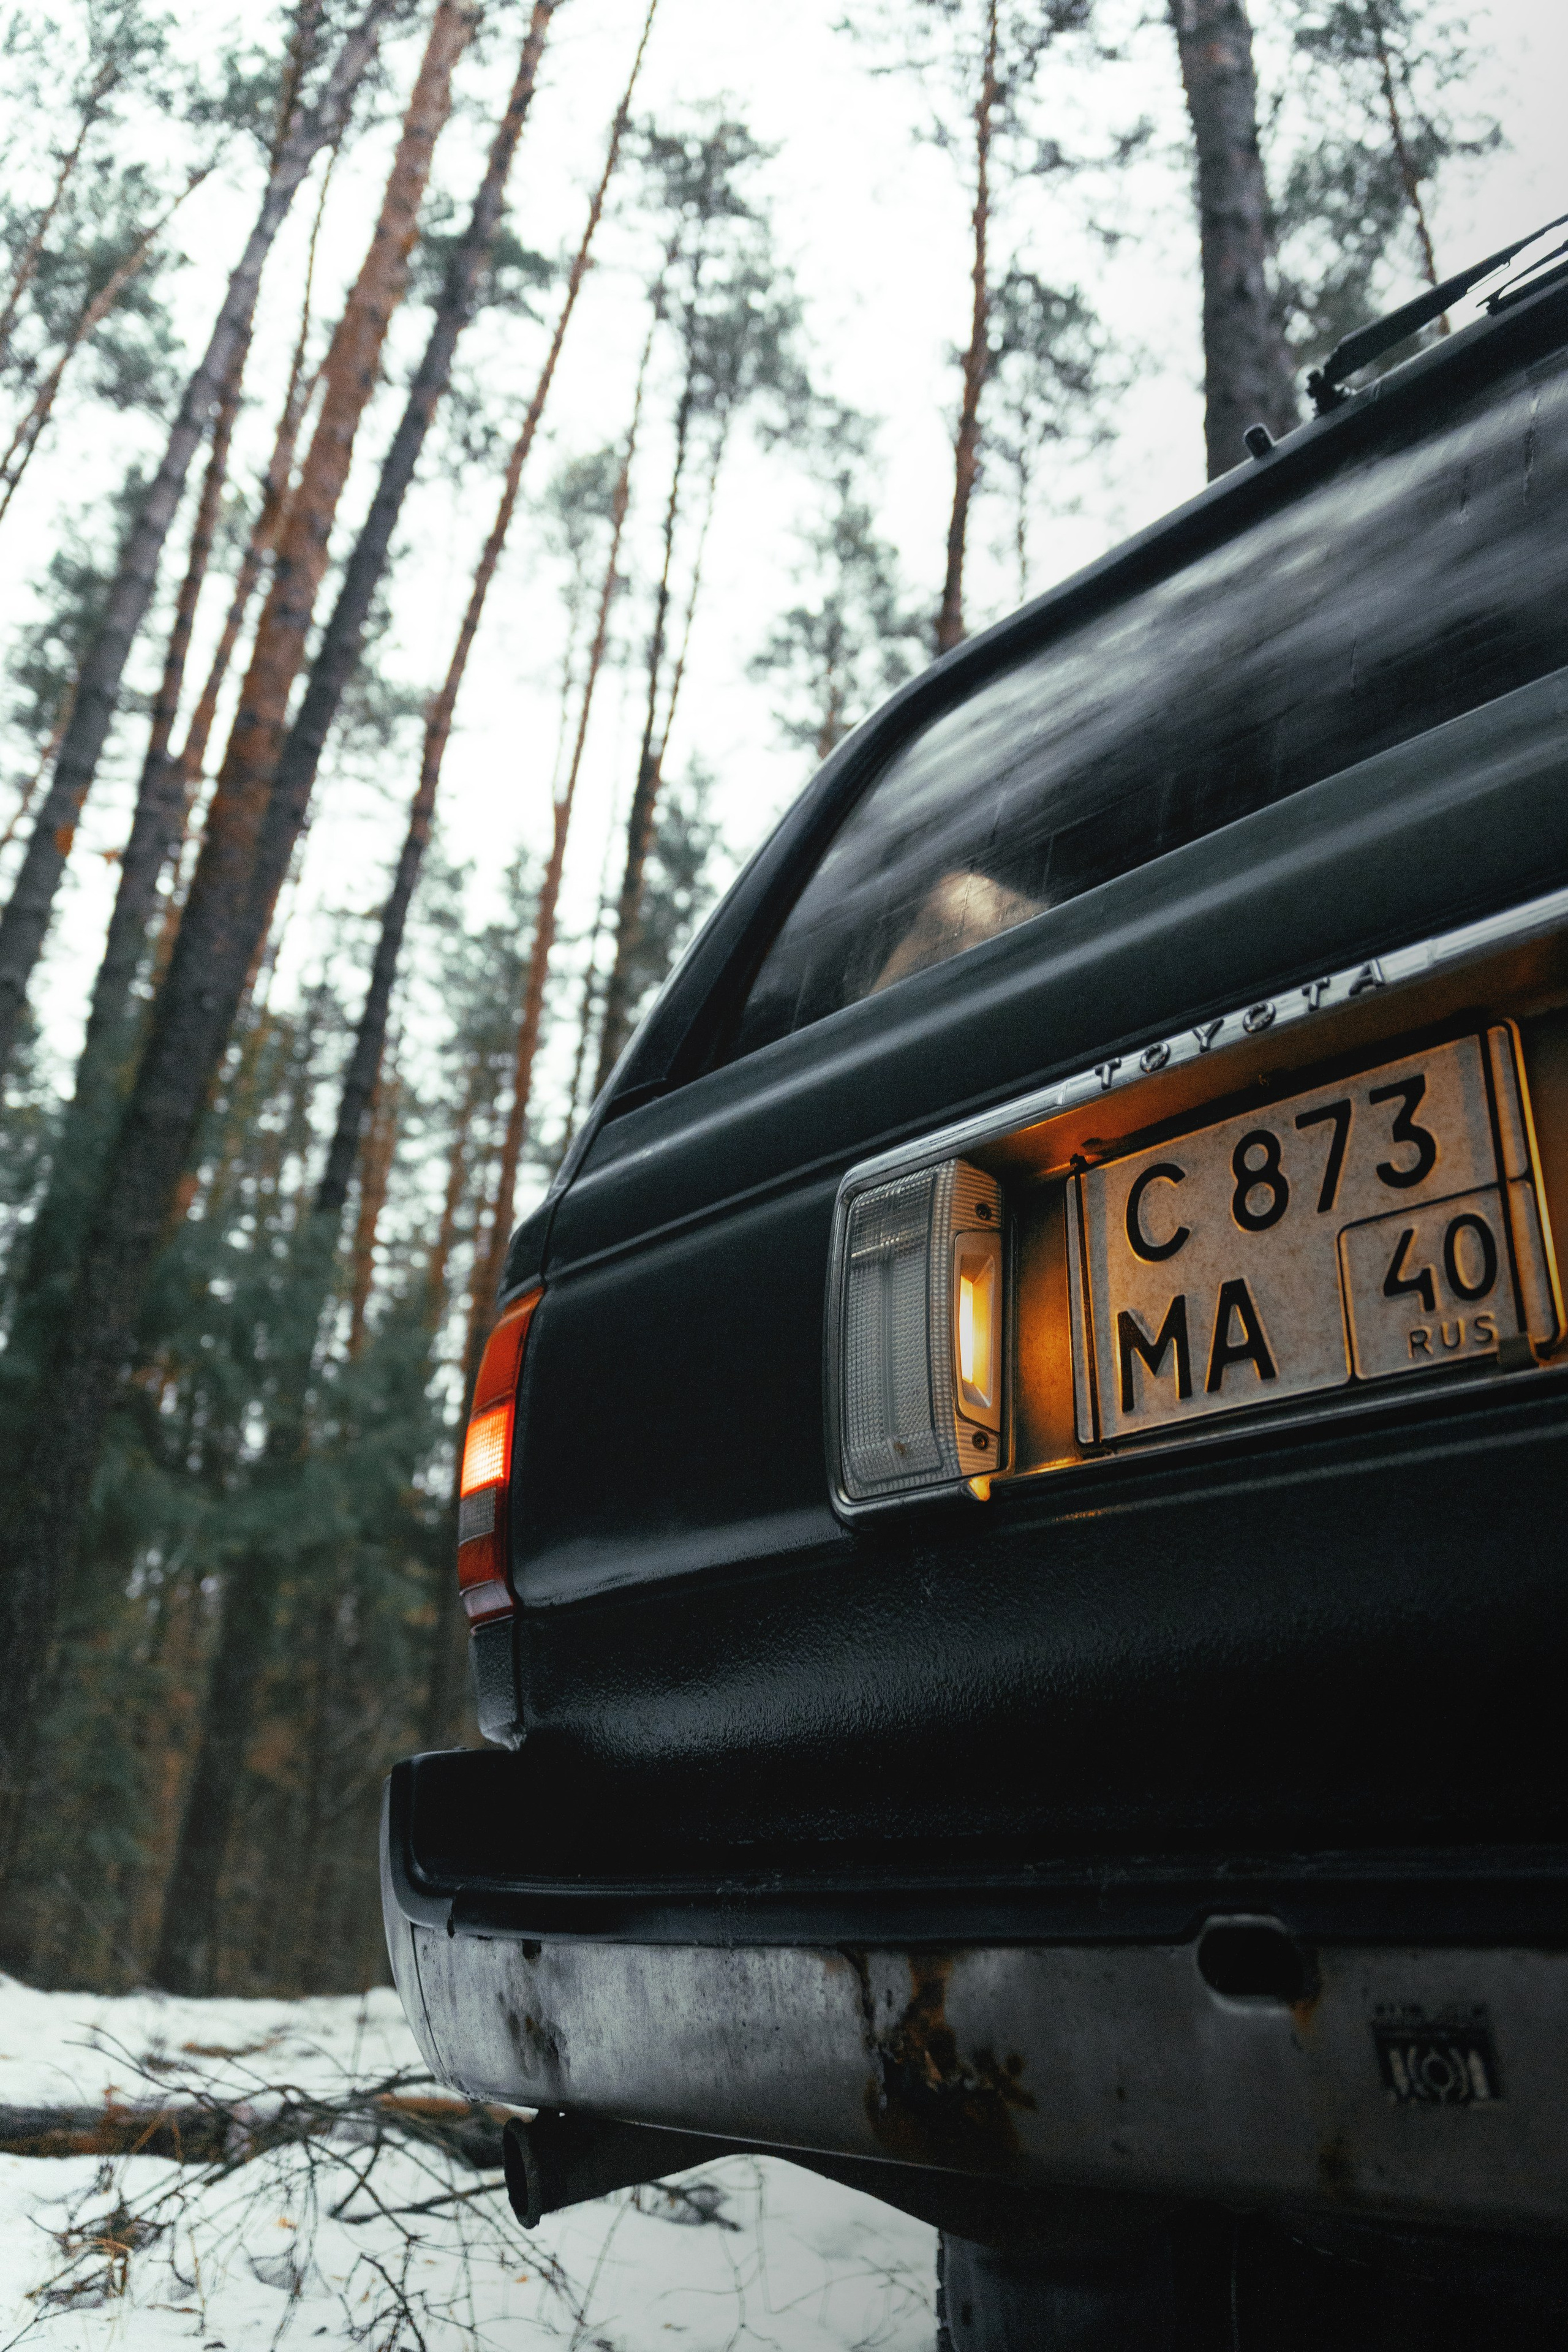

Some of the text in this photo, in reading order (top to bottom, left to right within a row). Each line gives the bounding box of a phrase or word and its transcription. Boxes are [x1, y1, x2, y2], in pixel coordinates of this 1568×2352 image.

[1095, 959, 1386, 1089] TOYOTA
[1232, 1073, 1436, 1232] 873
[1382, 1212, 1498, 1313] 40
[1117, 1278, 1279, 1414] MA
[1408, 1312, 1500, 1359] RUS
